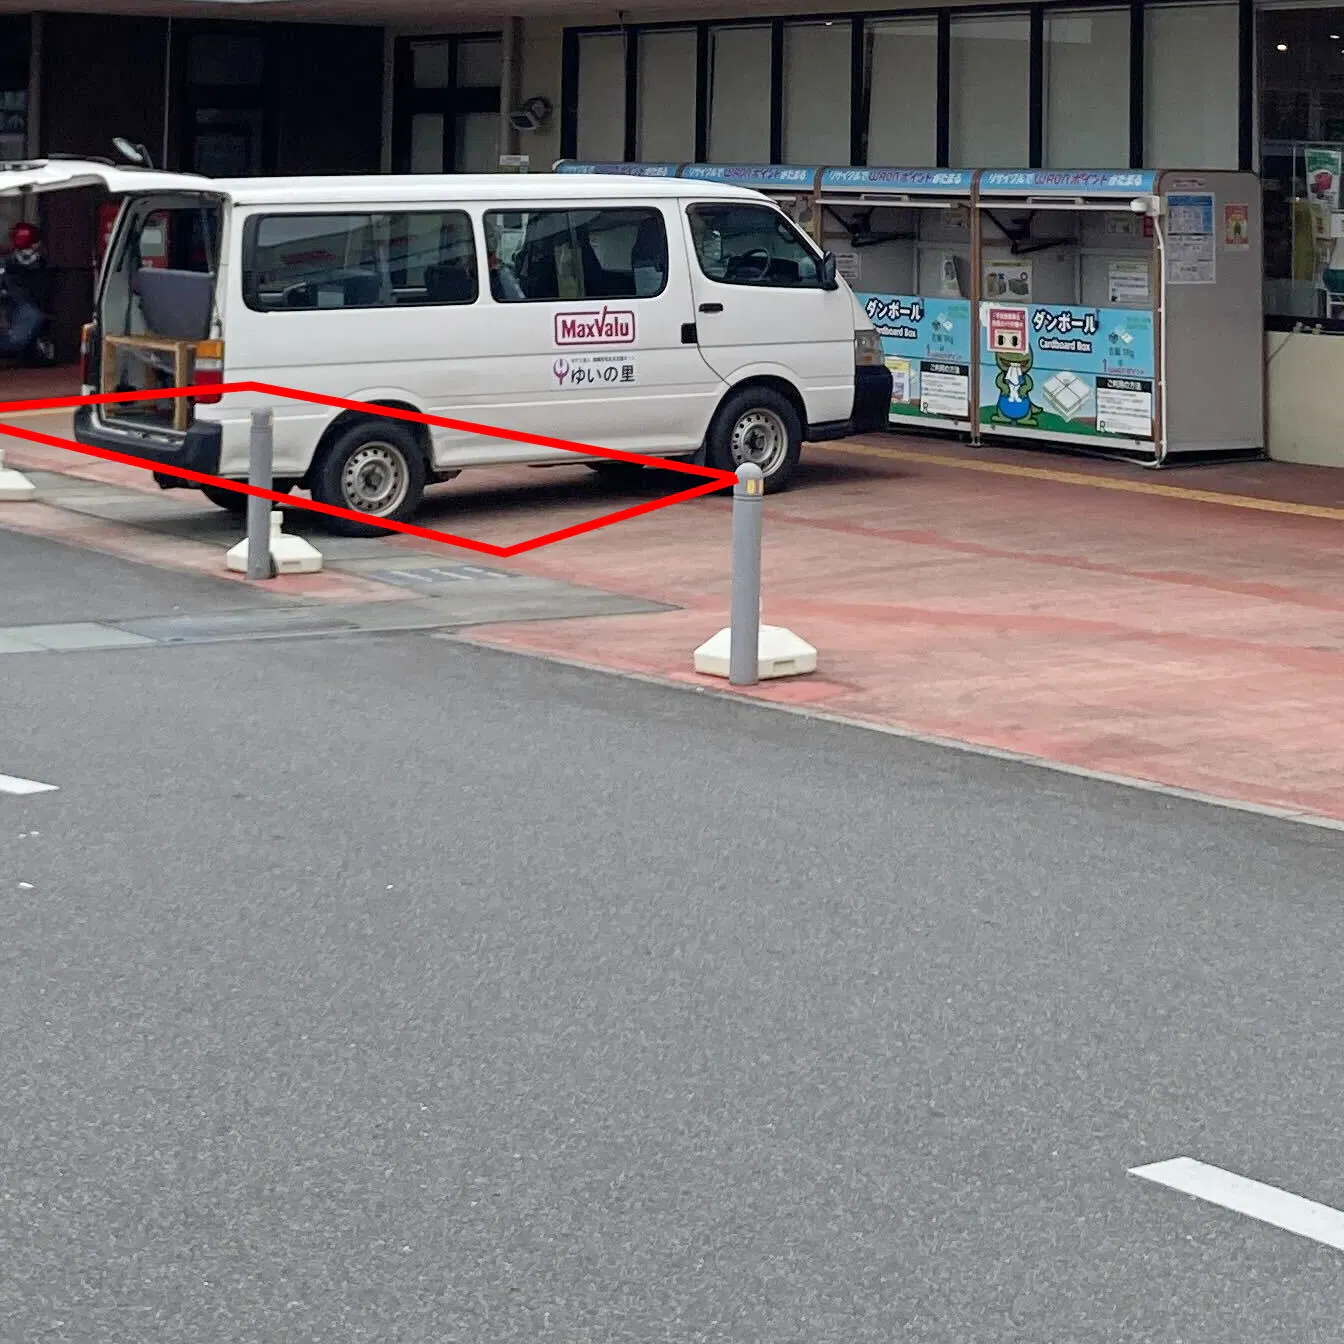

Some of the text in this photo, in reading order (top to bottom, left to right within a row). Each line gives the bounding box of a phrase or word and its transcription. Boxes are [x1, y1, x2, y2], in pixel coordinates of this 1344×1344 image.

[866, 298, 922, 321] ダンボール
[561, 305, 630, 339] MaxValu
[1032, 309, 1097, 335] ダンボール
[571, 365, 636, 384] ゆいの里
